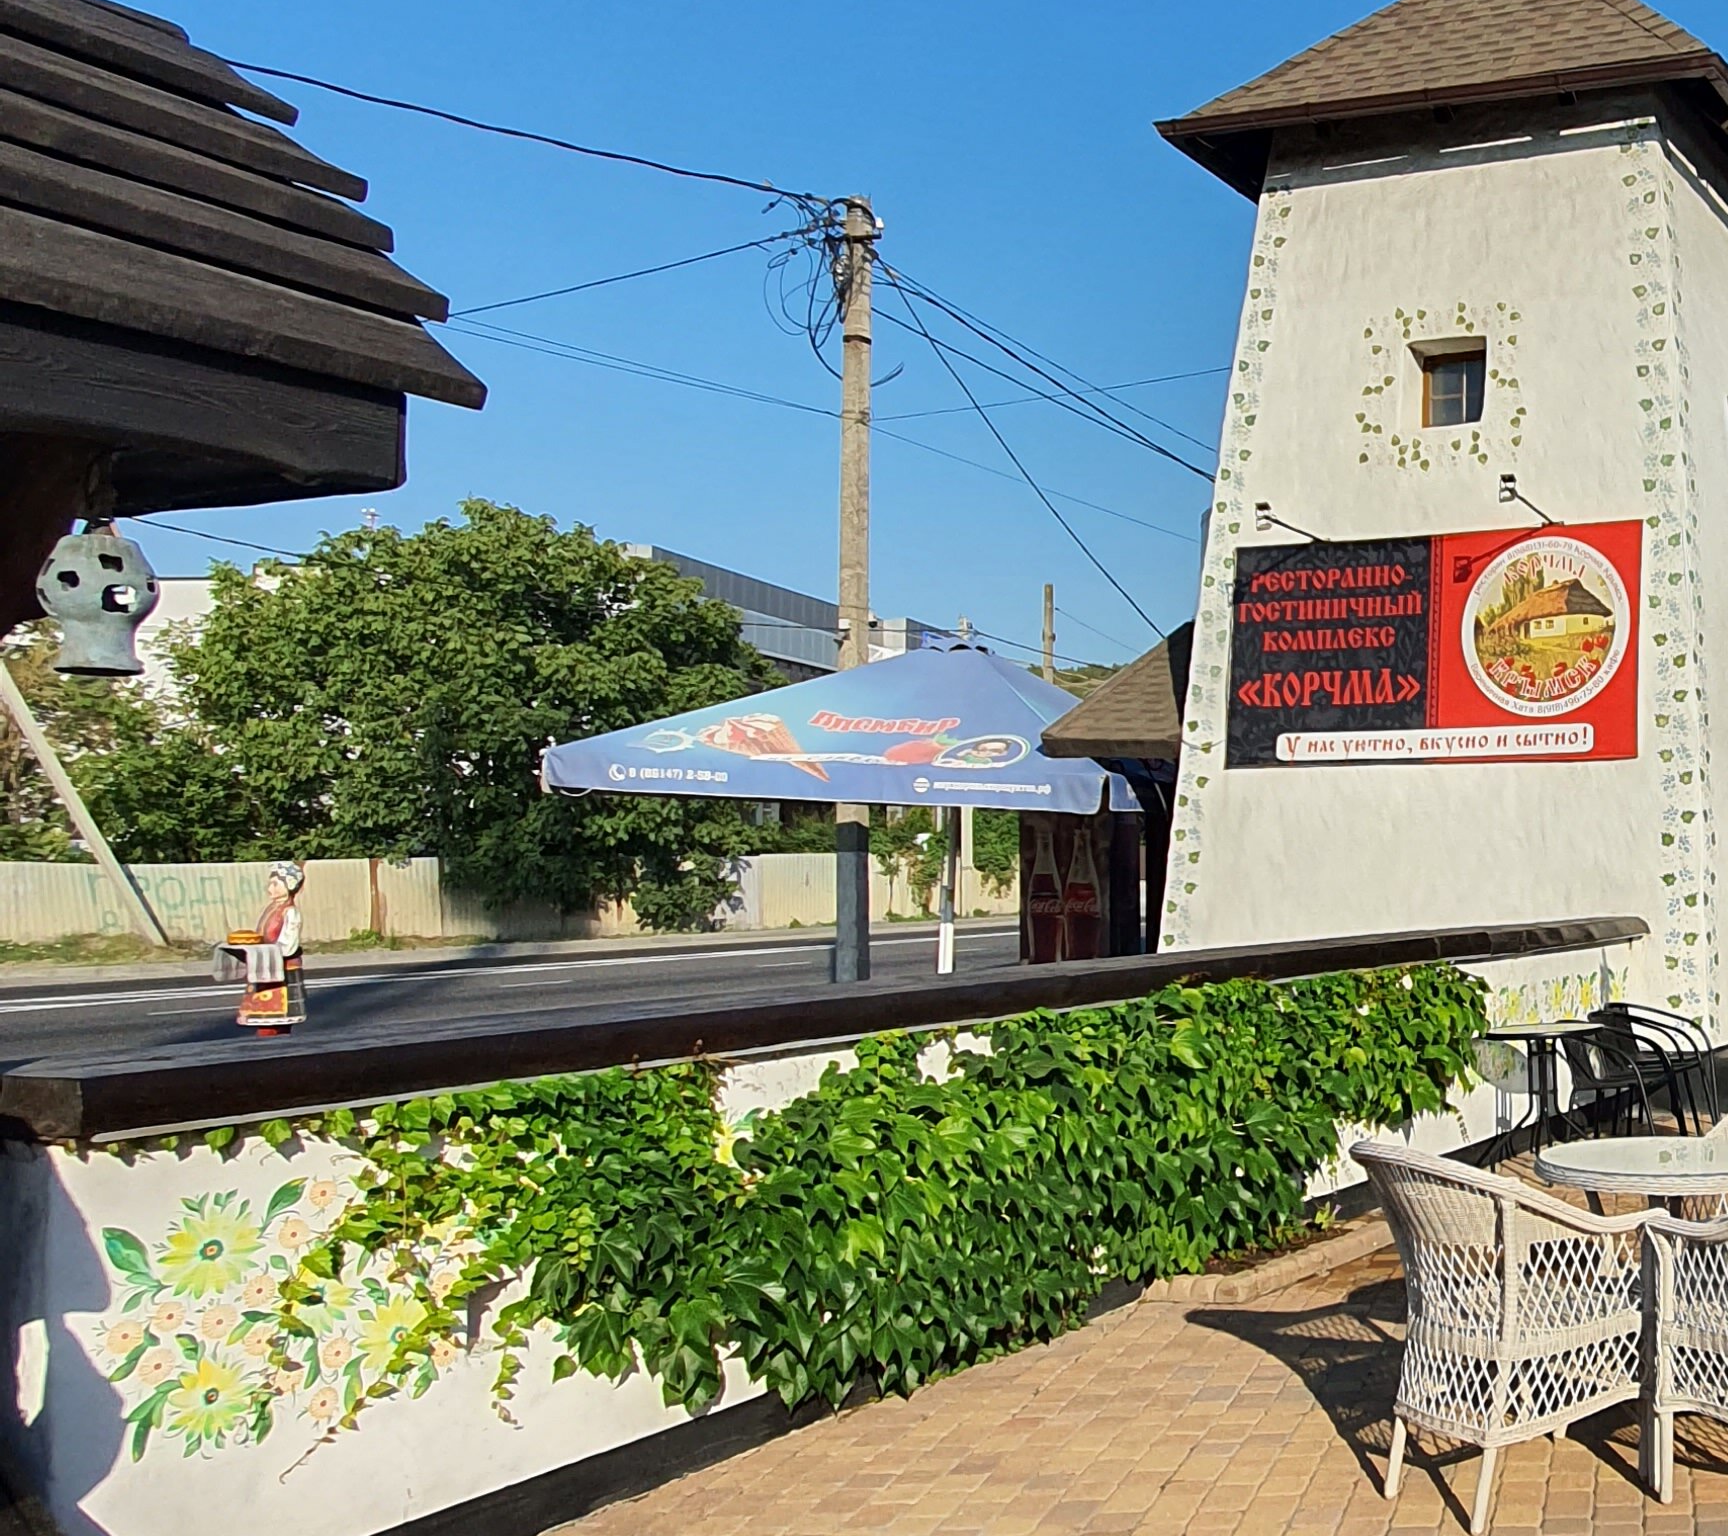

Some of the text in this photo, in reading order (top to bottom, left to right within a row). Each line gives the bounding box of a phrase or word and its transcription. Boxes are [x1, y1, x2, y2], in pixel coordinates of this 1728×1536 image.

[1251, 564, 1413, 593] РЕСТОРАННО-
[1238, 590, 1422, 623] ГОСТИНИЧНЫЙ
[1263, 626, 1396, 652] КОМПЛЕКС
[1238, 668, 1421, 707] «КОРЧМА»
[1512, 700, 1534, 713] Хата
[1285, 736, 1301, 761] У
[1308, 739, 1335, 753] нас
[1420, 734, 1489, 755] вкусно
[1497, 735, 1507, 748] и
[1516, 726, 1588, 747] сытно!
